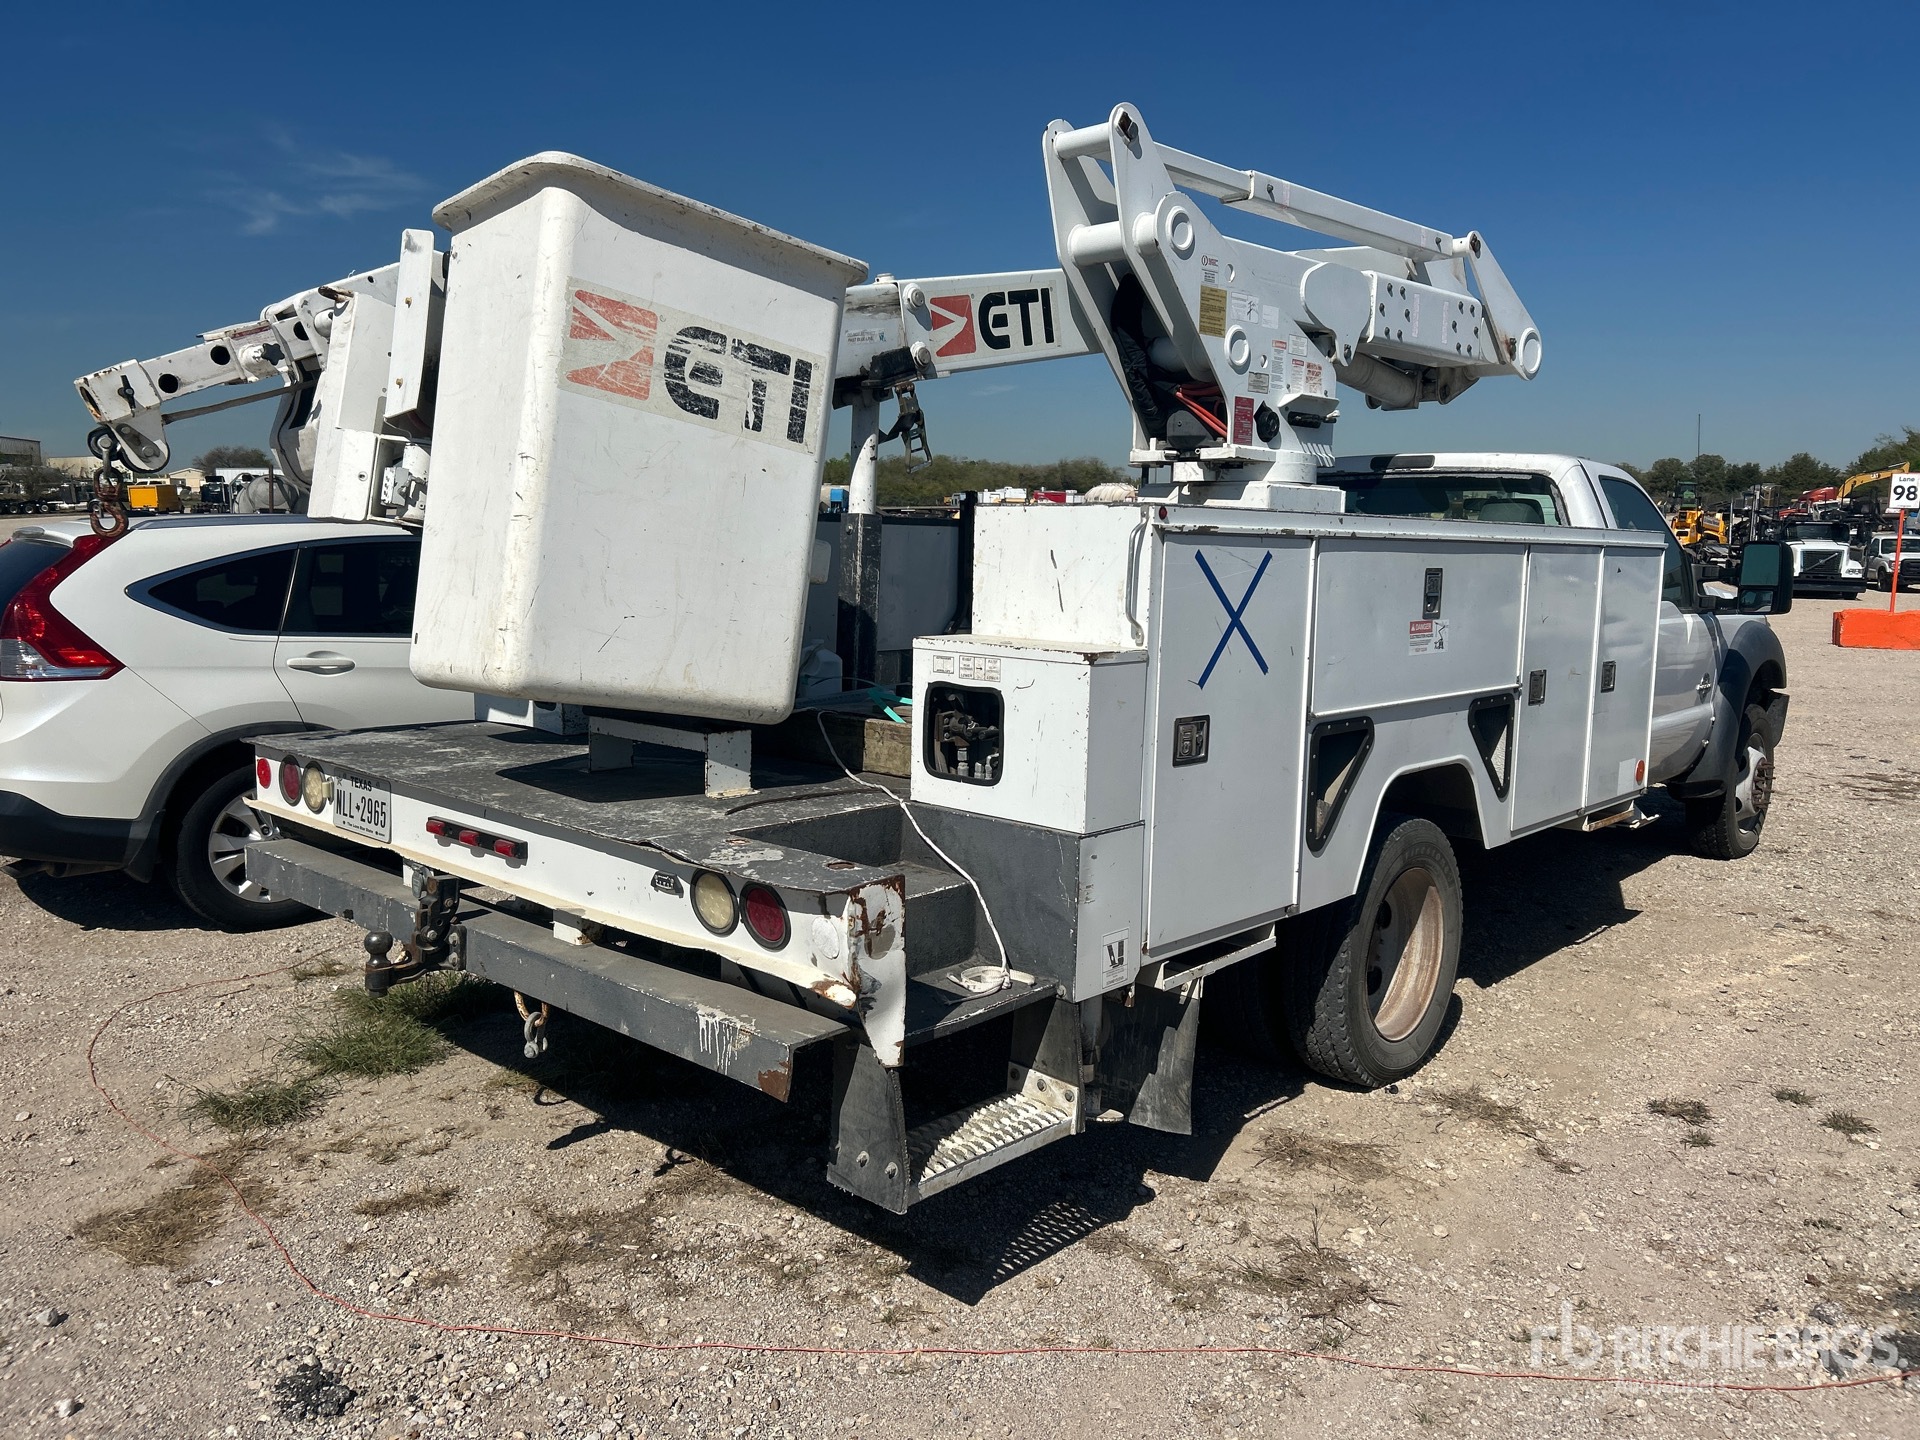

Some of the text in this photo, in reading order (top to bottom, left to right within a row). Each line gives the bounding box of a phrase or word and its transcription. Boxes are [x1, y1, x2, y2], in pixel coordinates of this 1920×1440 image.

[978, 287, 1055, 350] ETI
[664, 326, 812, 443] ETI
[1893, 485, 1918, 501] 98
[351, 776, 372, 791] TEXAS
[336, 788, 386, 828] NLL 2965
